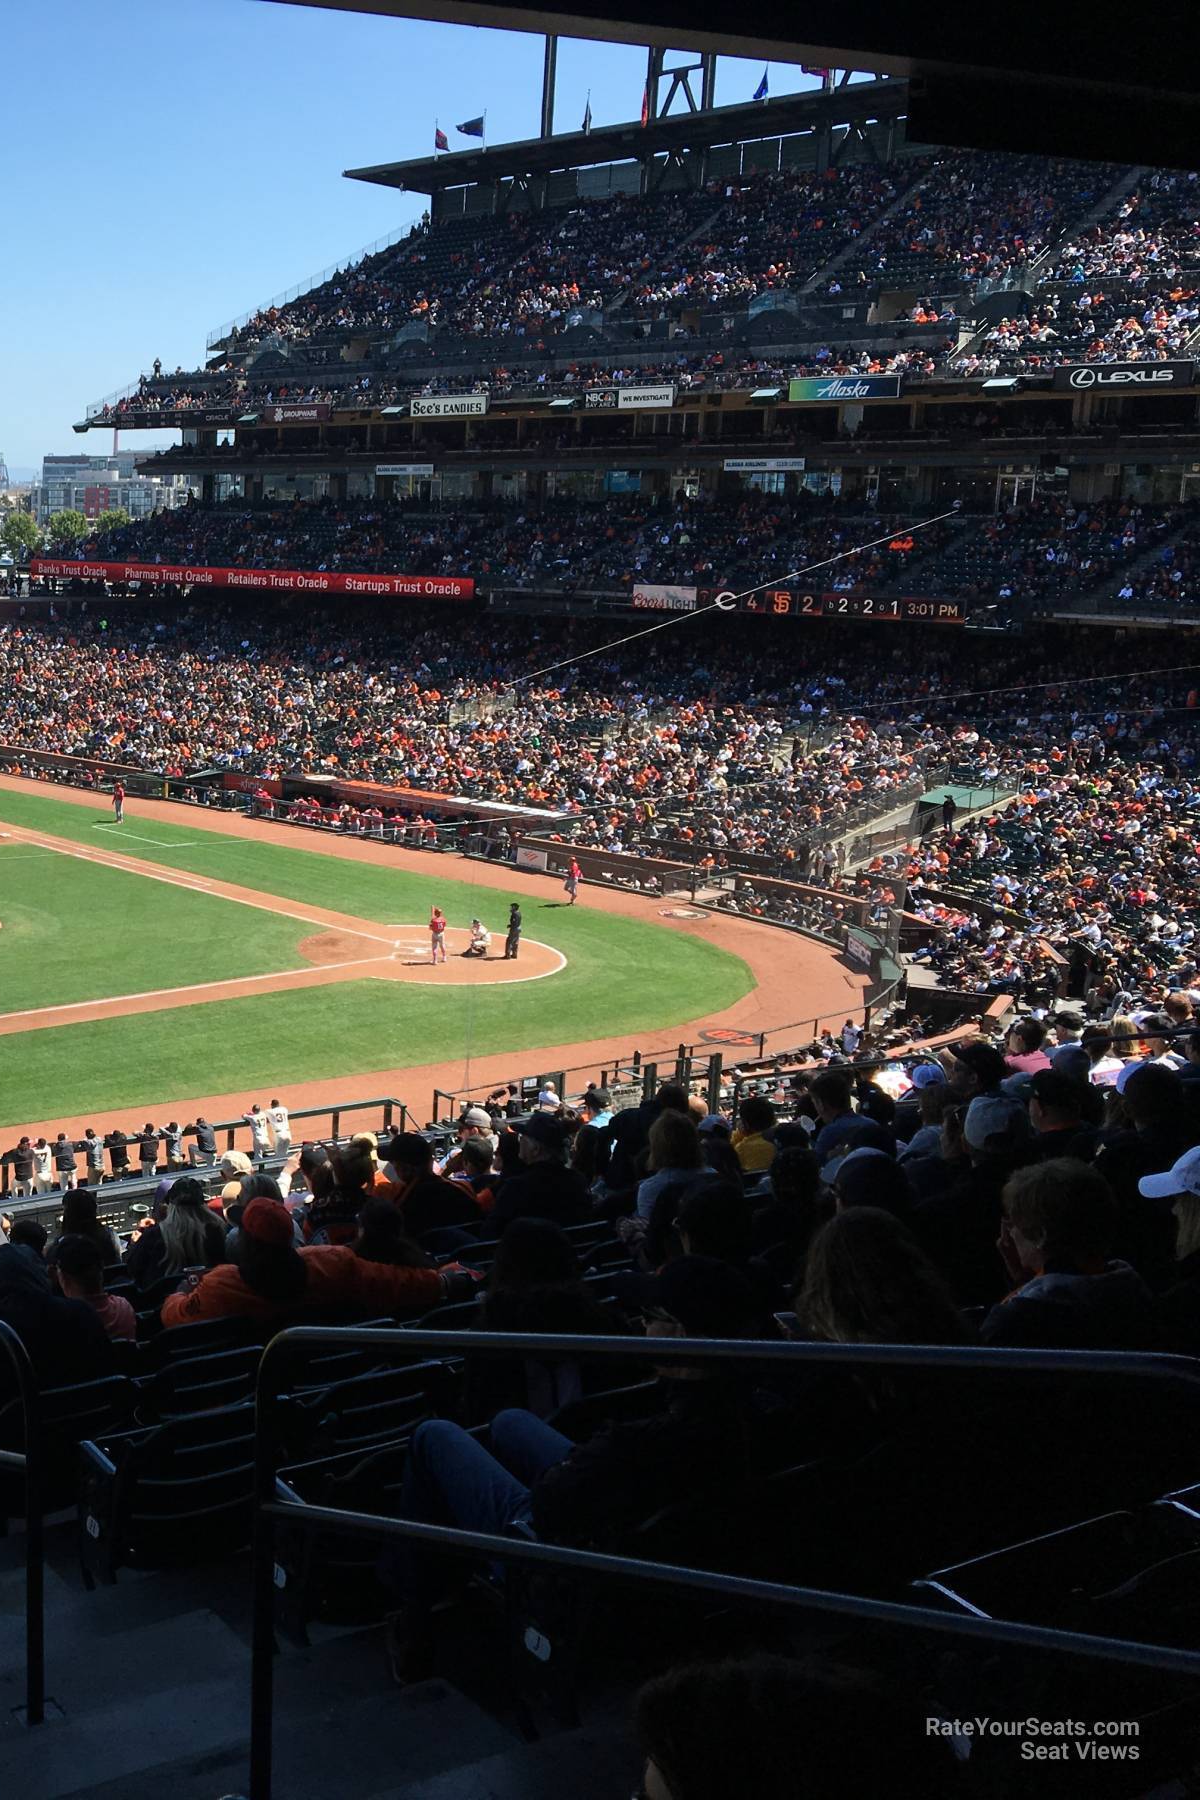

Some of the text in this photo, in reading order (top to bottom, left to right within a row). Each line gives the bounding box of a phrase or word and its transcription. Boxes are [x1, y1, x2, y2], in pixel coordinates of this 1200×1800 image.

[1097, 369, 1174, 383] LEXUS
[817, 379, 870, 397] Alaska
[585, 392, 604, 402] NBC
[283, 409, 318, 418] GROUPWARE
[412, 401, 482, 415] See's CANDIES
[38, 563, 107, 577] Banks Trust Oracle
[125, 567, 213, 582] Pharmas Trust Oracle
[227, 572, 329, 589] Retailers Trust Oracle
[345, 578, 461, 595] Startups Trust Oracle
[746, 594, 758, 609] 4
[802, 596, 814, 613] 2
[837, 598, 848, 613] 2
[863, 600, 873, 615] 2
[890, 601, 898, 615] 1
[907, 602, 934, 615] 3:01
[938, 604, 959, 617] PM
